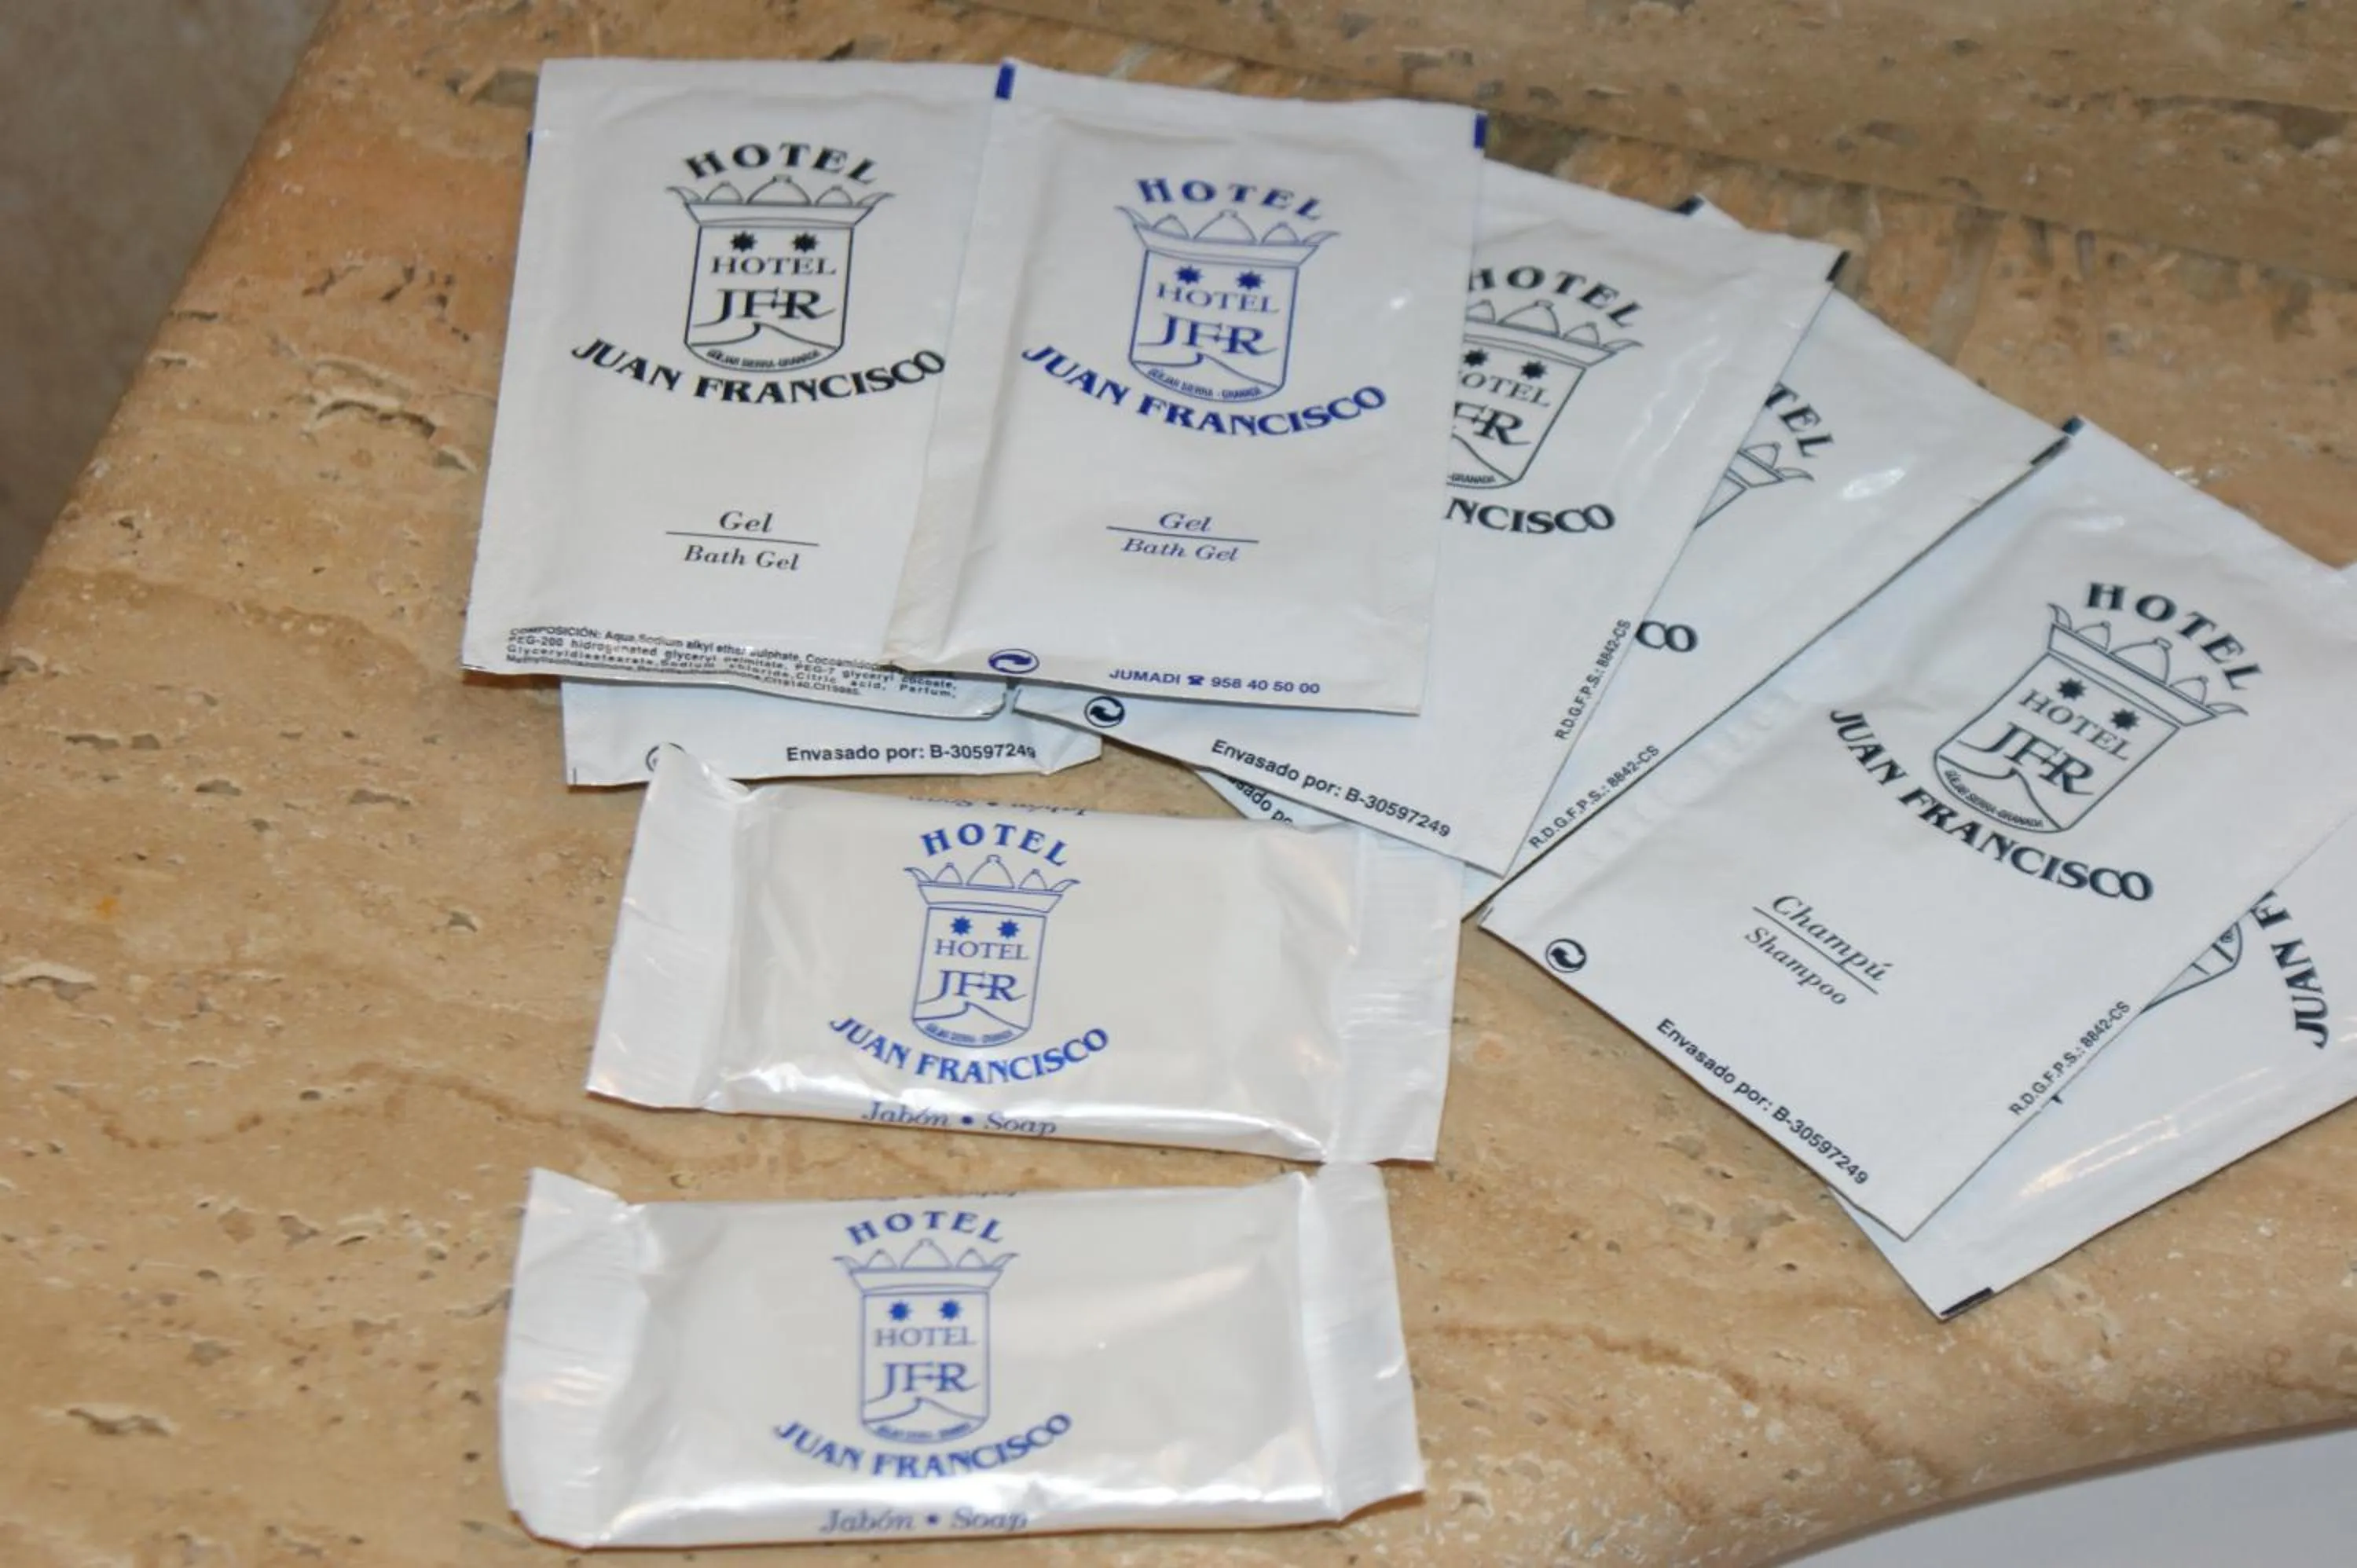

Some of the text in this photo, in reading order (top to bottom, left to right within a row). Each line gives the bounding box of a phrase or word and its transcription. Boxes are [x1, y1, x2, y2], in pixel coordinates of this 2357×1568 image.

[682, 141, 878, 185] HOTEL
[1135, 177, 1325, 221] HOTEL
[710, 256, 837, 275] HOTEL
[692, 286, 836, 328] JFR
[1157, 282, 1280, 313] HOTEL
[1468, 265, 1643, 329] HOTEL
[1137, 314, 1277, 356] JFR
[571, 339, 946, 405] JUAN FRANCISCO
[1022, 345, 1387, 436] JUAN FRANCISCO
[1459, 372, 1551, 408] OTEL
[1453, 400, 1531, 446] FR
[1761, 382, 1835, 460] TEL
[718, 509, 772, 533] Gel
[1159, 511, 1212, 533] Gel
[1444, 496, 1616, 535] NCISCO
[684, 544, 800, 572] Bath Gel
[1121, 537, 1240, 562] Bath Gel
[2084, 581, 2263, 691] HOTEL
[1109, 669, 1321, 694] JUMADI 958 40 50 00
[2018, 688, 2132, 761] HOTEL
[786, 745, 880, 761] Envasado
[885, 745, 925, 763] por:
[1956, 721, 2095, 797] JFR
[1211, 738, 1452, 839] Envasado por: B-30597249
[1829, 709, 2154, 902] JUAN FRANCISCO
[921, 822, 1069, 866] HOTEL
[934, 939, 1029, 960] HOTEL
[1771, 894, 1893, 982] Champú
[1743, 925, 1848, 1006] Shampoo
[918, 969, 1028, 1006] JFR
[2270, 938, 2329, 1049] JUAN
[829, 1017, 912, 1070] JUAN
[915, 1028, 1109, 1084] FRANCISCO
[861, 1100, 1057, 1137] Jabón Soap
[1655, 1017, 1869, 1185] Envasado por: B-30597249
[845, 1210, 1004, 1246] HOTEL
[874, 1326, 978, 1348] HOTEL
[864, 1361, 981, 1404] JFR
[773, 1412, 1073, 1478] JUAN FRANCISCO
[818, 1505, 1029, 1533] Jabón Soap
